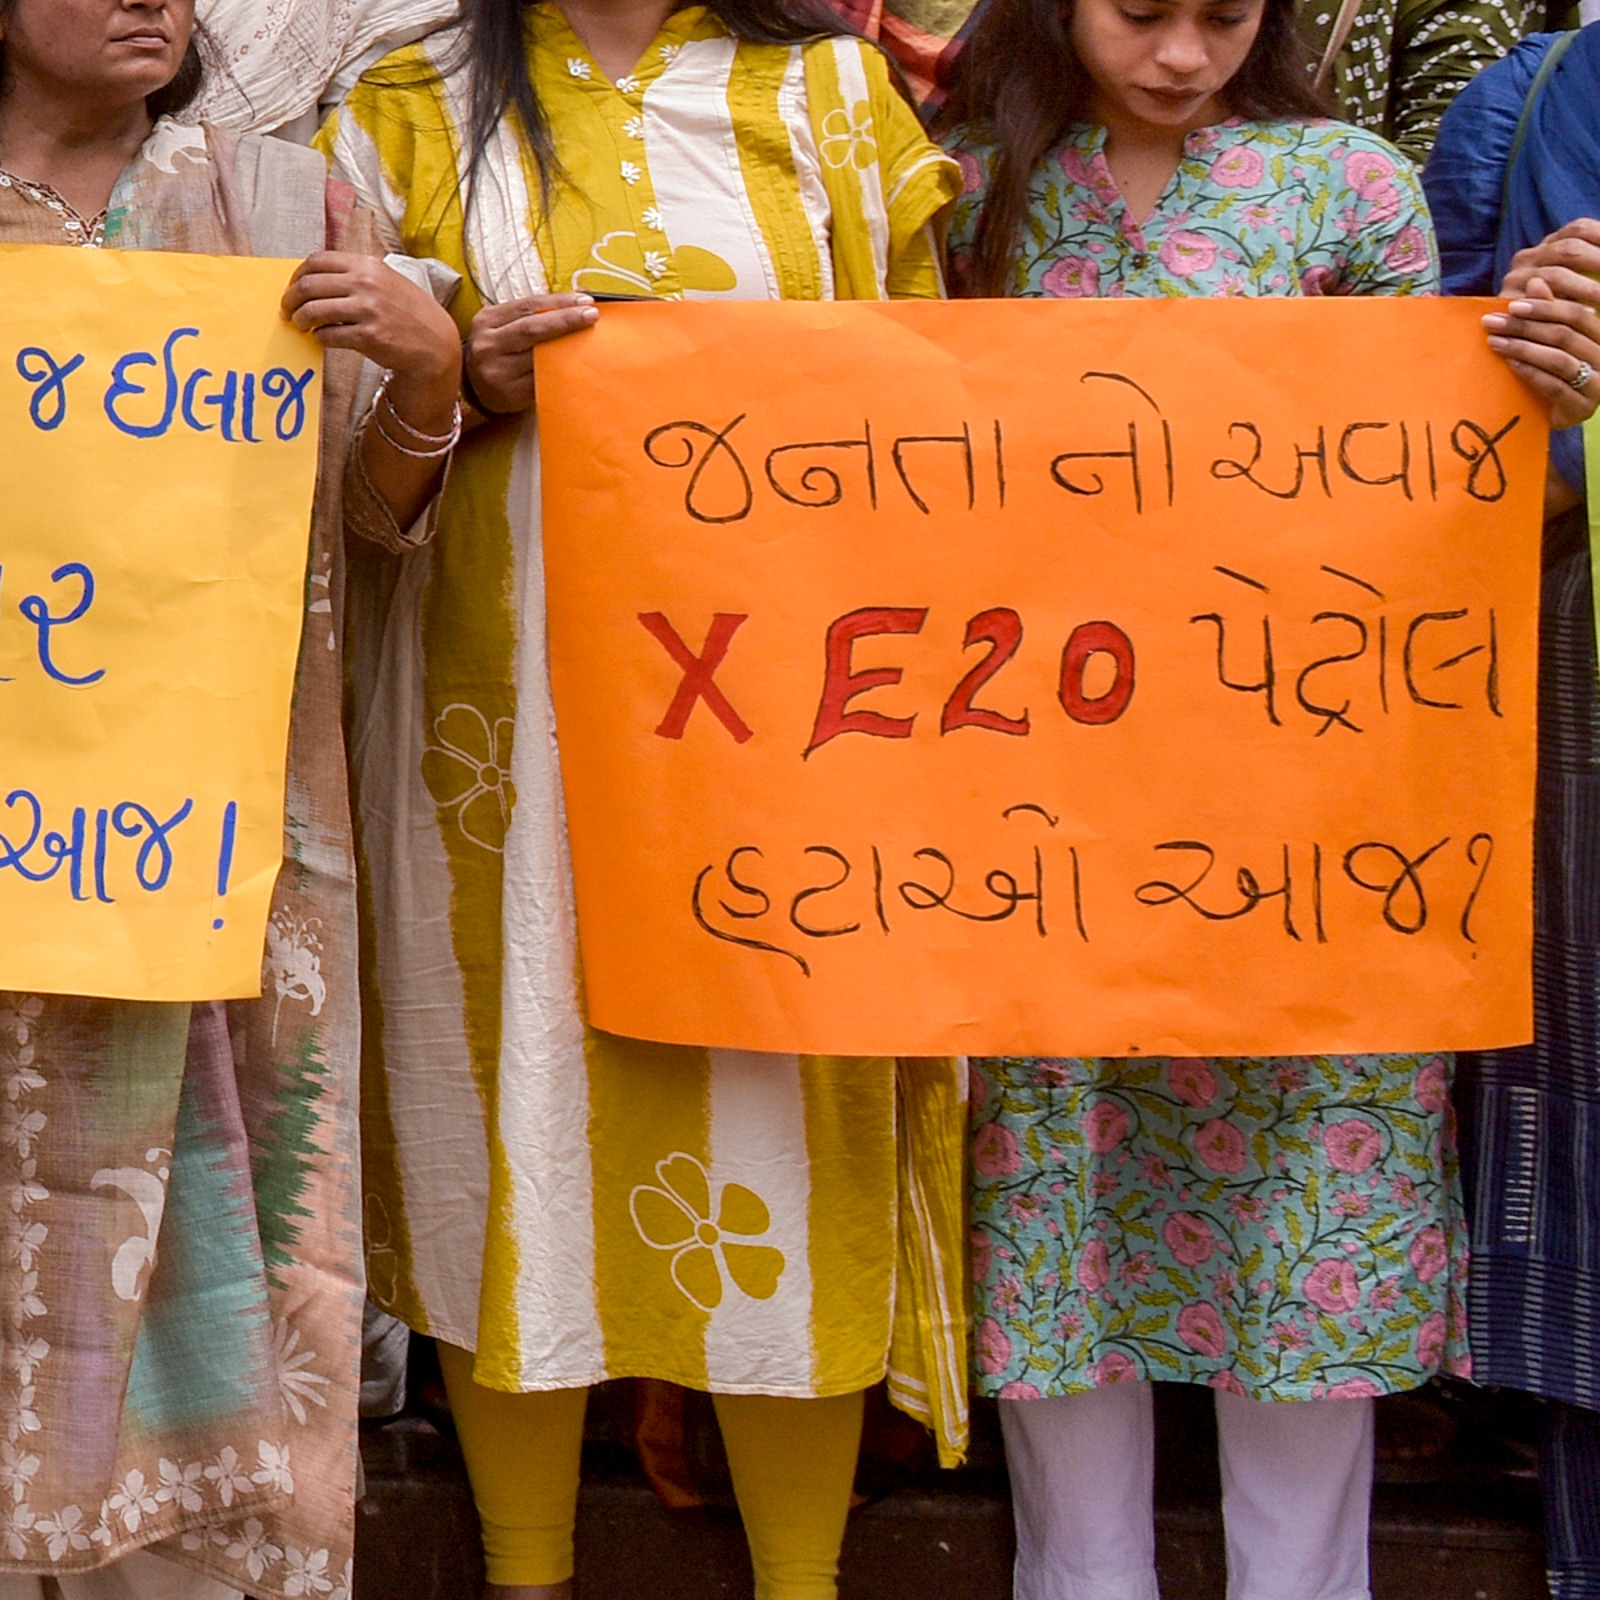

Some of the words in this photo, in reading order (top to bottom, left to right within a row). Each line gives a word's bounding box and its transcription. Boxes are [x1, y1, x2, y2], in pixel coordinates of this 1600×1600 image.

[16, 347, 85, 431] જ
[644, 414, 1005, 524] જનતા
[1050, 372, 1173, 514] નો
[1210, 416, 1520, 502] અવાજ
[801, 607, 1135, 761] E20
[1190, 566, 1502, 736] પેટ્રોલ
[692, 804, 1088, 977] હટાઓ
